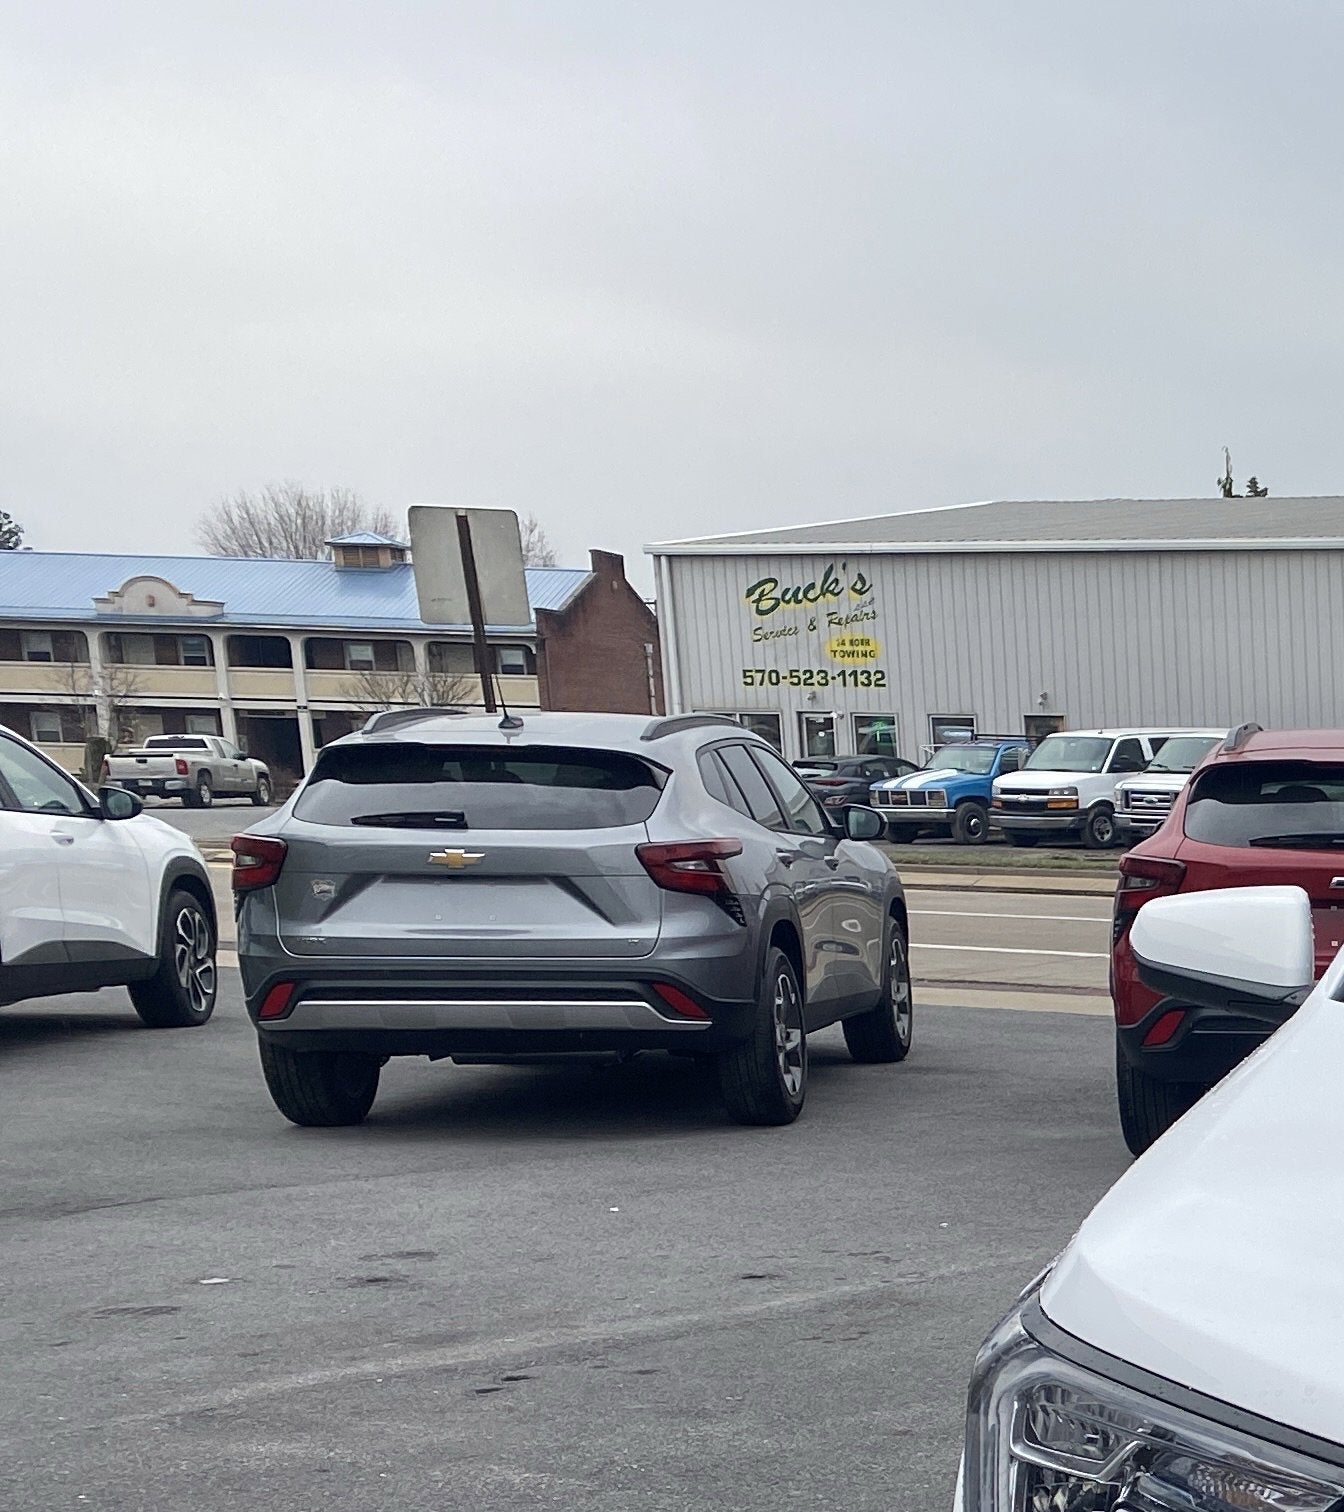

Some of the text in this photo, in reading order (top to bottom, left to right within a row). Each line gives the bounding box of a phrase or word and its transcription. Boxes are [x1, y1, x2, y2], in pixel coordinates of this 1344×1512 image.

[745, 562, 873, 616] Buck's
[807, 616, 817, 632] &
[826, 609, 878, 630] Repairs
[831, 649, 876, 659] TOWING
[742, 669, 887, 688] 570-523-1132
